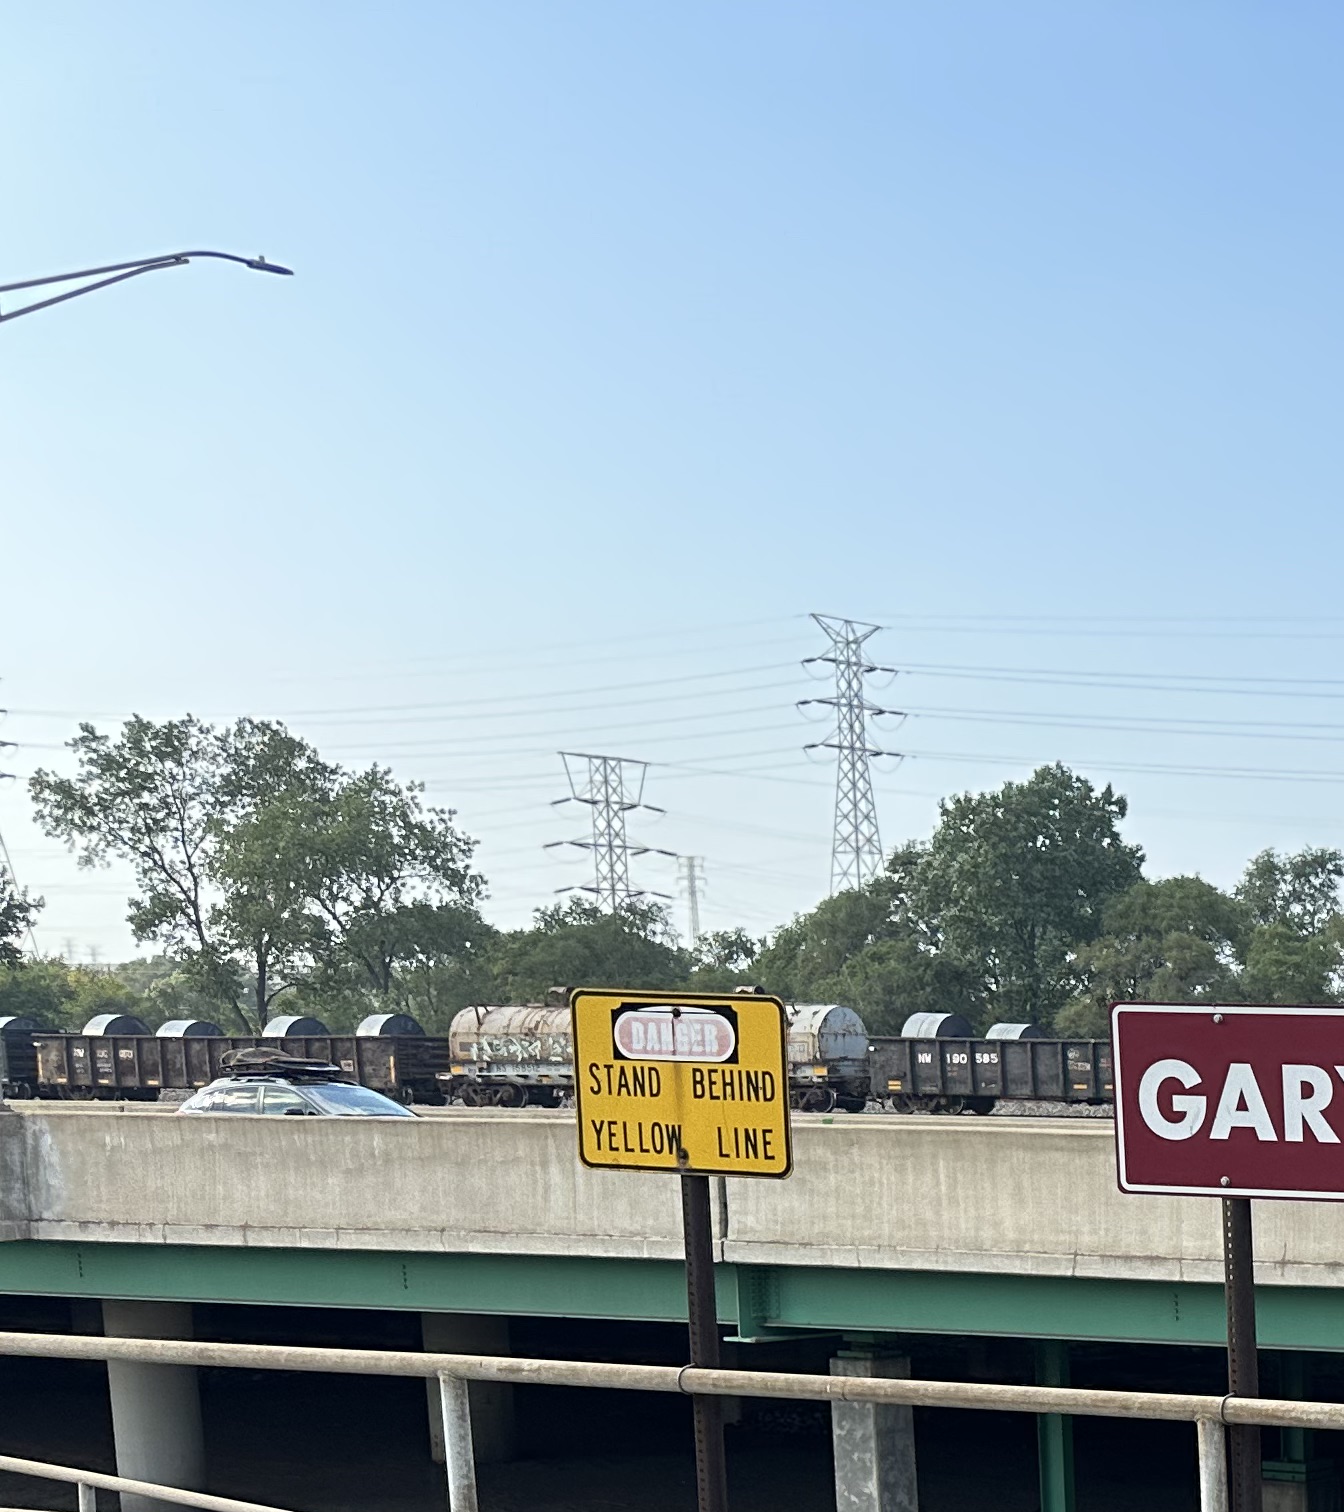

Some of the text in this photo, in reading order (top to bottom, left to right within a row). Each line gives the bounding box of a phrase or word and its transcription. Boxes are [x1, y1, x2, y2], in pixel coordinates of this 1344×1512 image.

[631, 1021, 719, 1052] DANGER
[917, 1053, 932, 1064] NW
[589, 1062, 775, 1102] STAND BEHIND
[591, 1119, 776, 1160] YELLOW LINE
